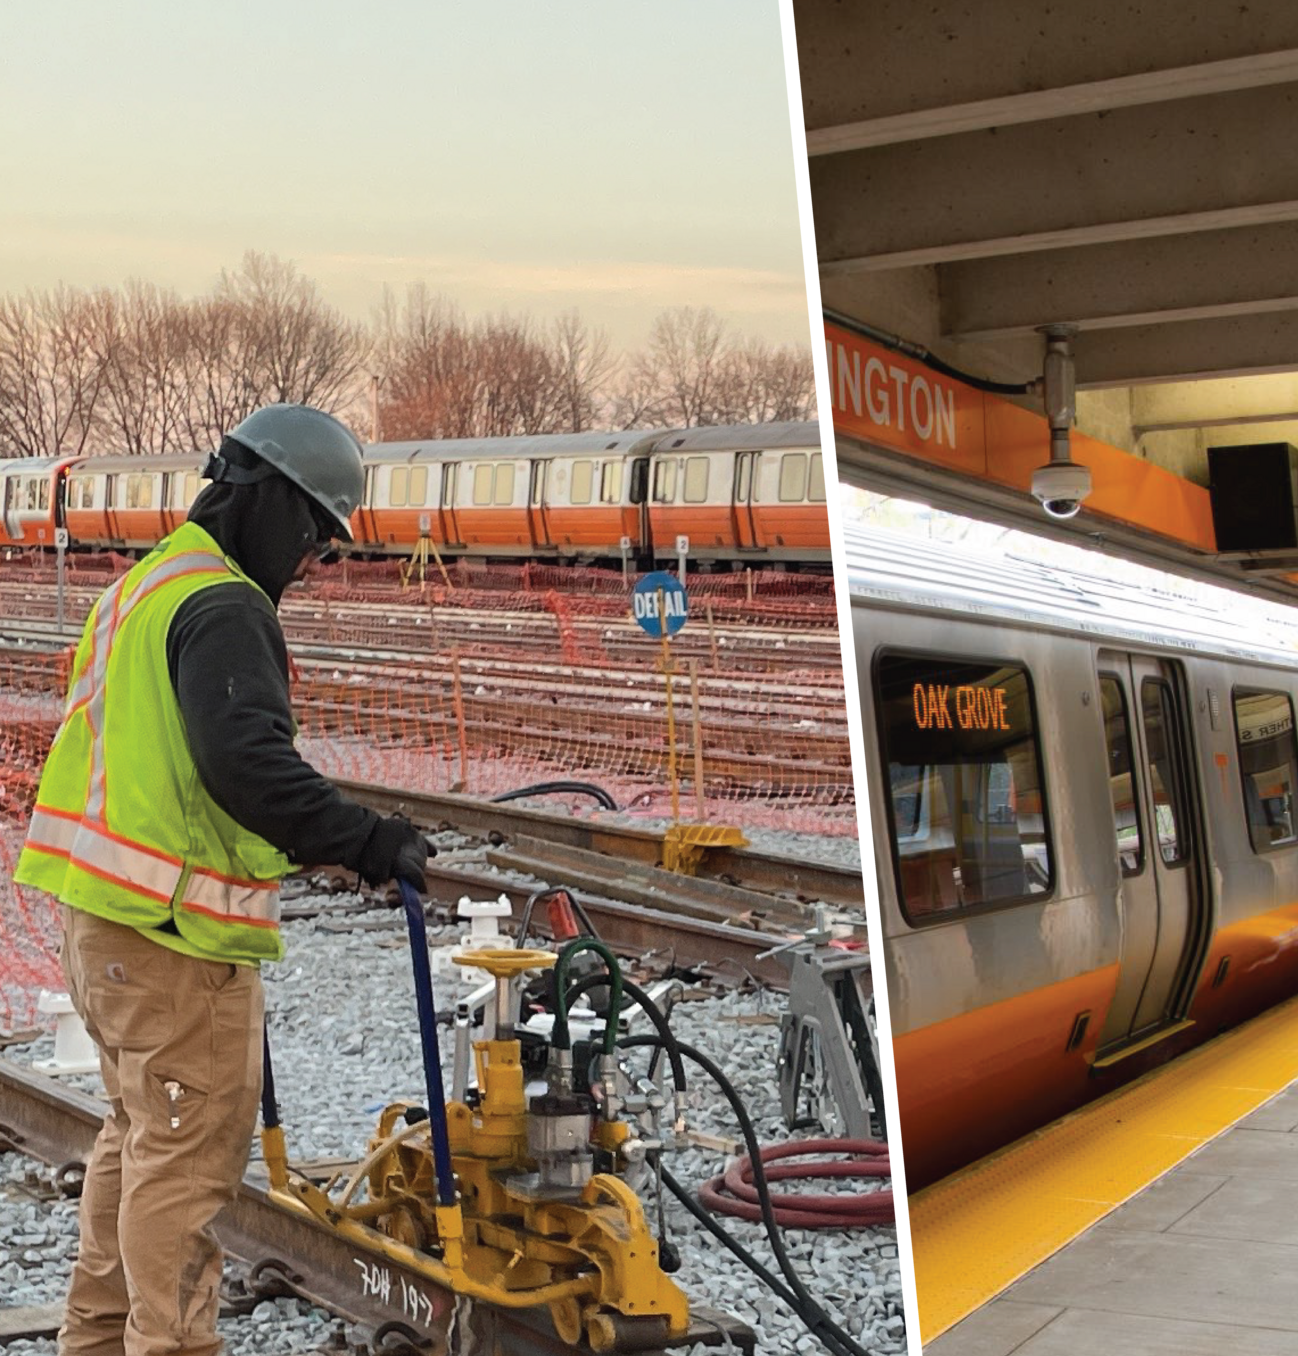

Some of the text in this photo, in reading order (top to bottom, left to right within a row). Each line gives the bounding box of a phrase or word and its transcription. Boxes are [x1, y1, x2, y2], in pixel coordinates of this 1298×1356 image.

[825, 339, 956, 449] INGTON
[58, 532, 66, 544] 2
[680, 540, 687, 550] 2
[913, 683, 1010, 730] OAK GROVE
